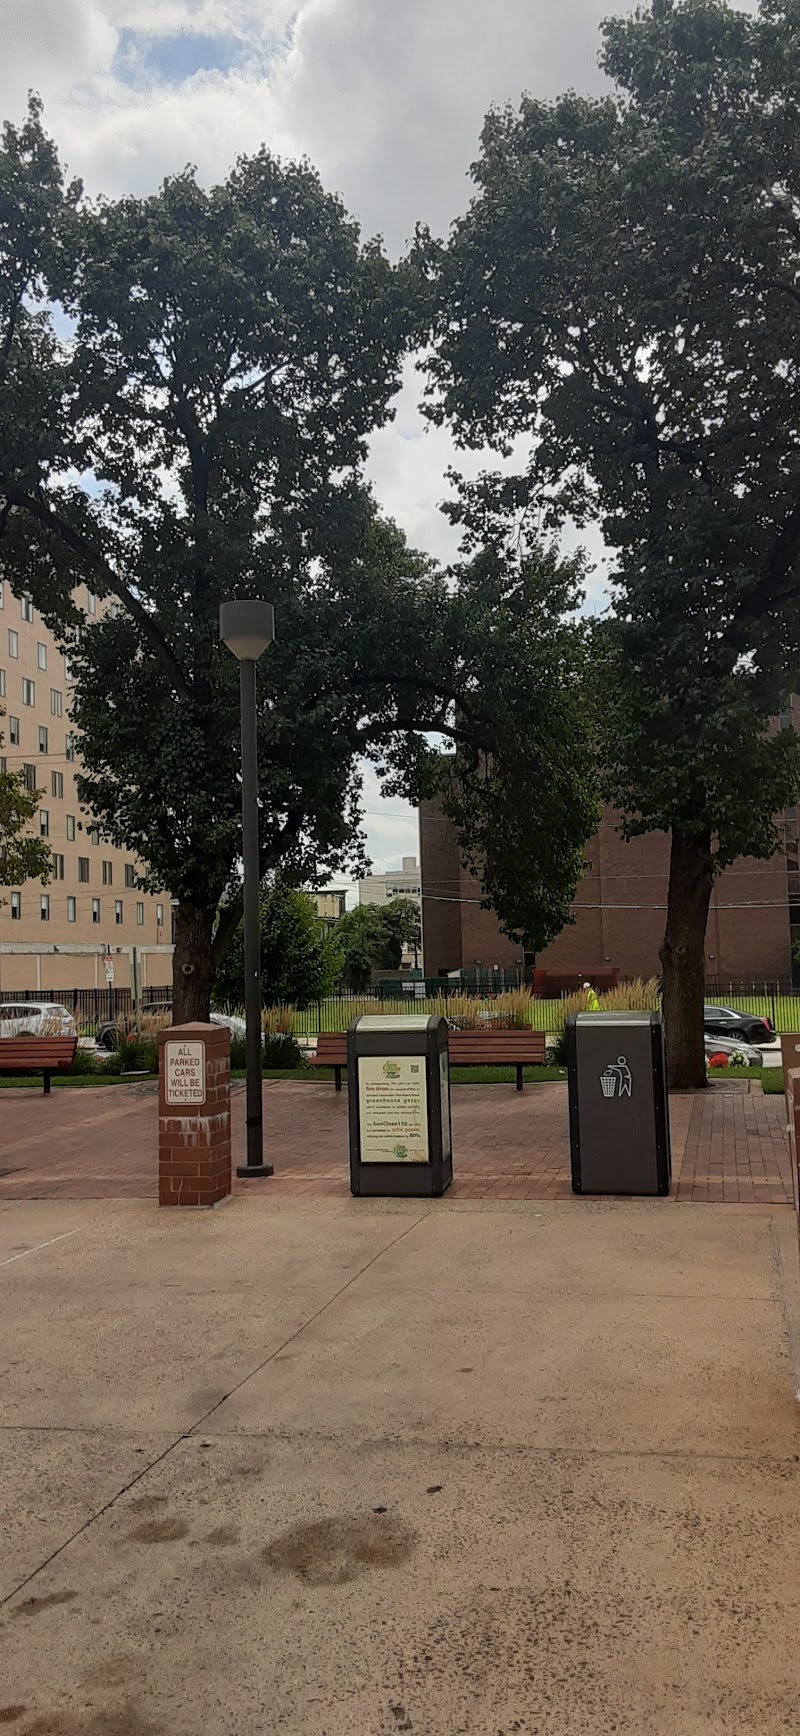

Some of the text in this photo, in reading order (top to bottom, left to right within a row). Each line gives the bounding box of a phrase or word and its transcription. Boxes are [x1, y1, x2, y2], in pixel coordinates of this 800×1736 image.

[178, 1048, 192, 1056] ALL
[170, 1058, 200, 1066] PARKED
[174, 1068, 196, 1077] CARS
[171, 1078, 200, 1087] WILL BE
[169, 1089, 203, 1098] TICKETED
